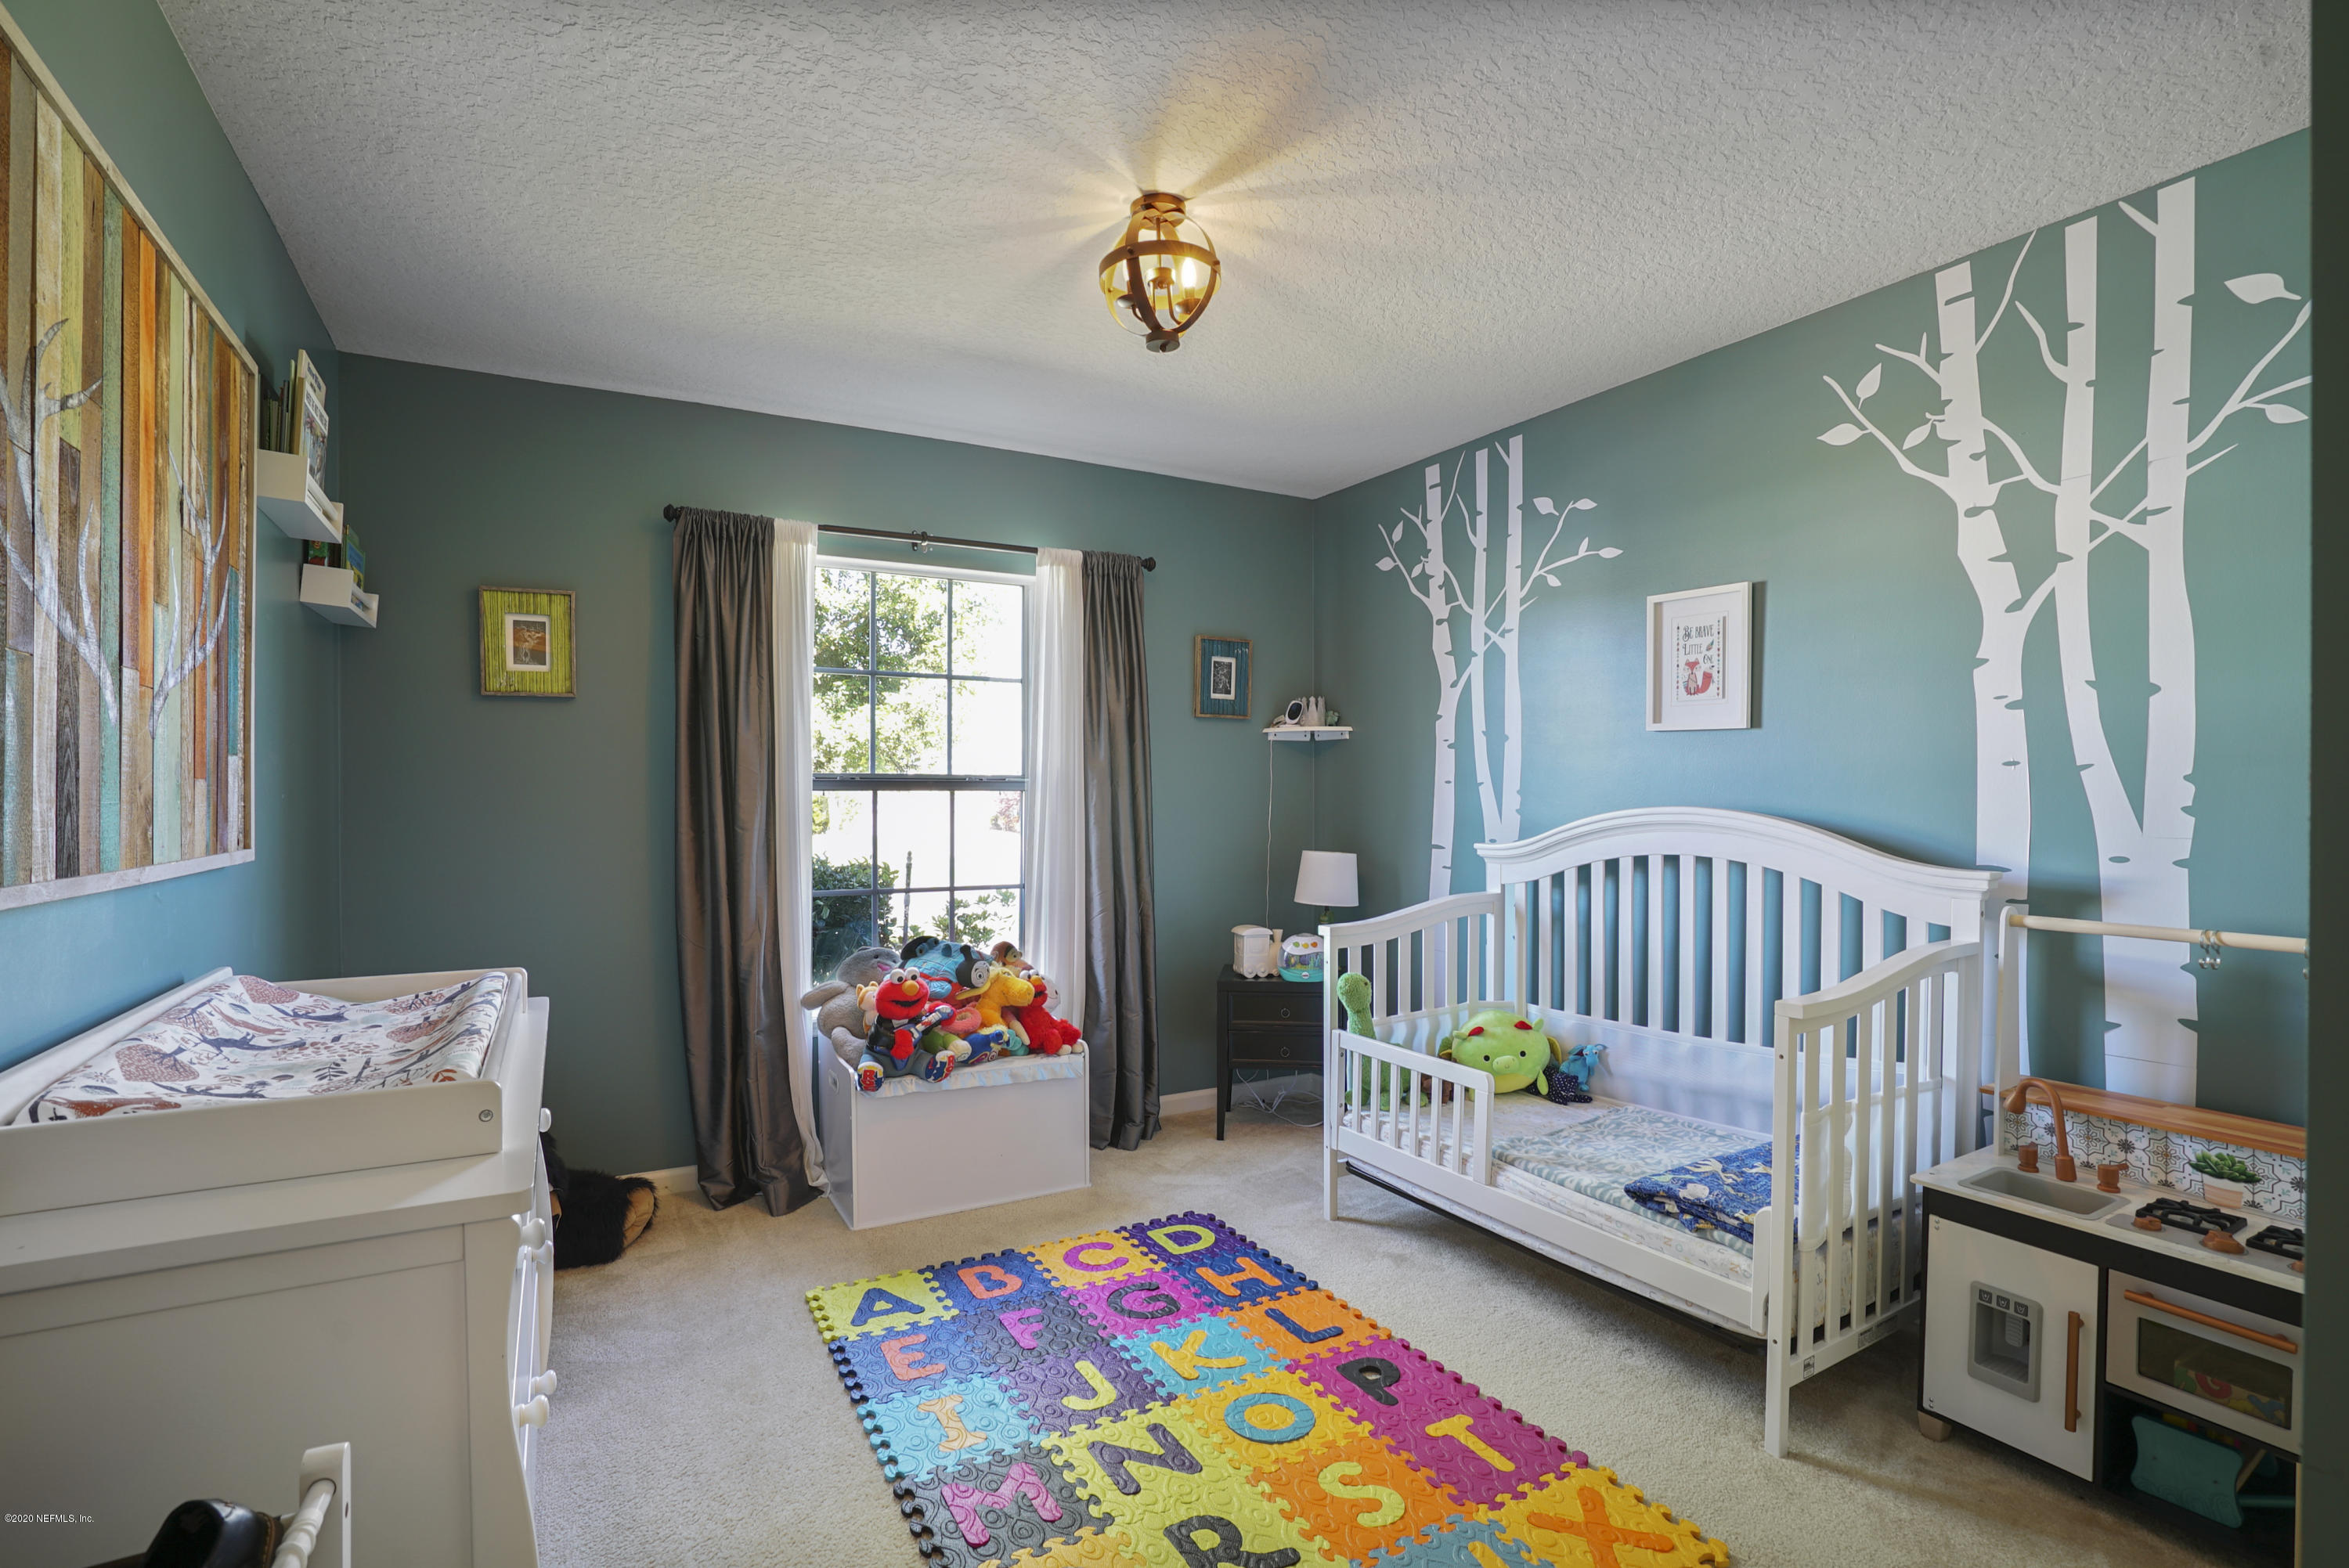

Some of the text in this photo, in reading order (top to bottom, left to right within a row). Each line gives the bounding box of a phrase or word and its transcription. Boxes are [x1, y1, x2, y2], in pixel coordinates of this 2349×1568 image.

[850, 1224, 1215, 1327] A B C D
[880, 1256, 1282, 1381] E F G H
[917, 1307, 1343, 1452] I J K L
[941, 1357, 1401, 1548] M N O P
[1163, 1414, 1514, 1568] R S T
[1528, 1487, 1674, 1568] X
